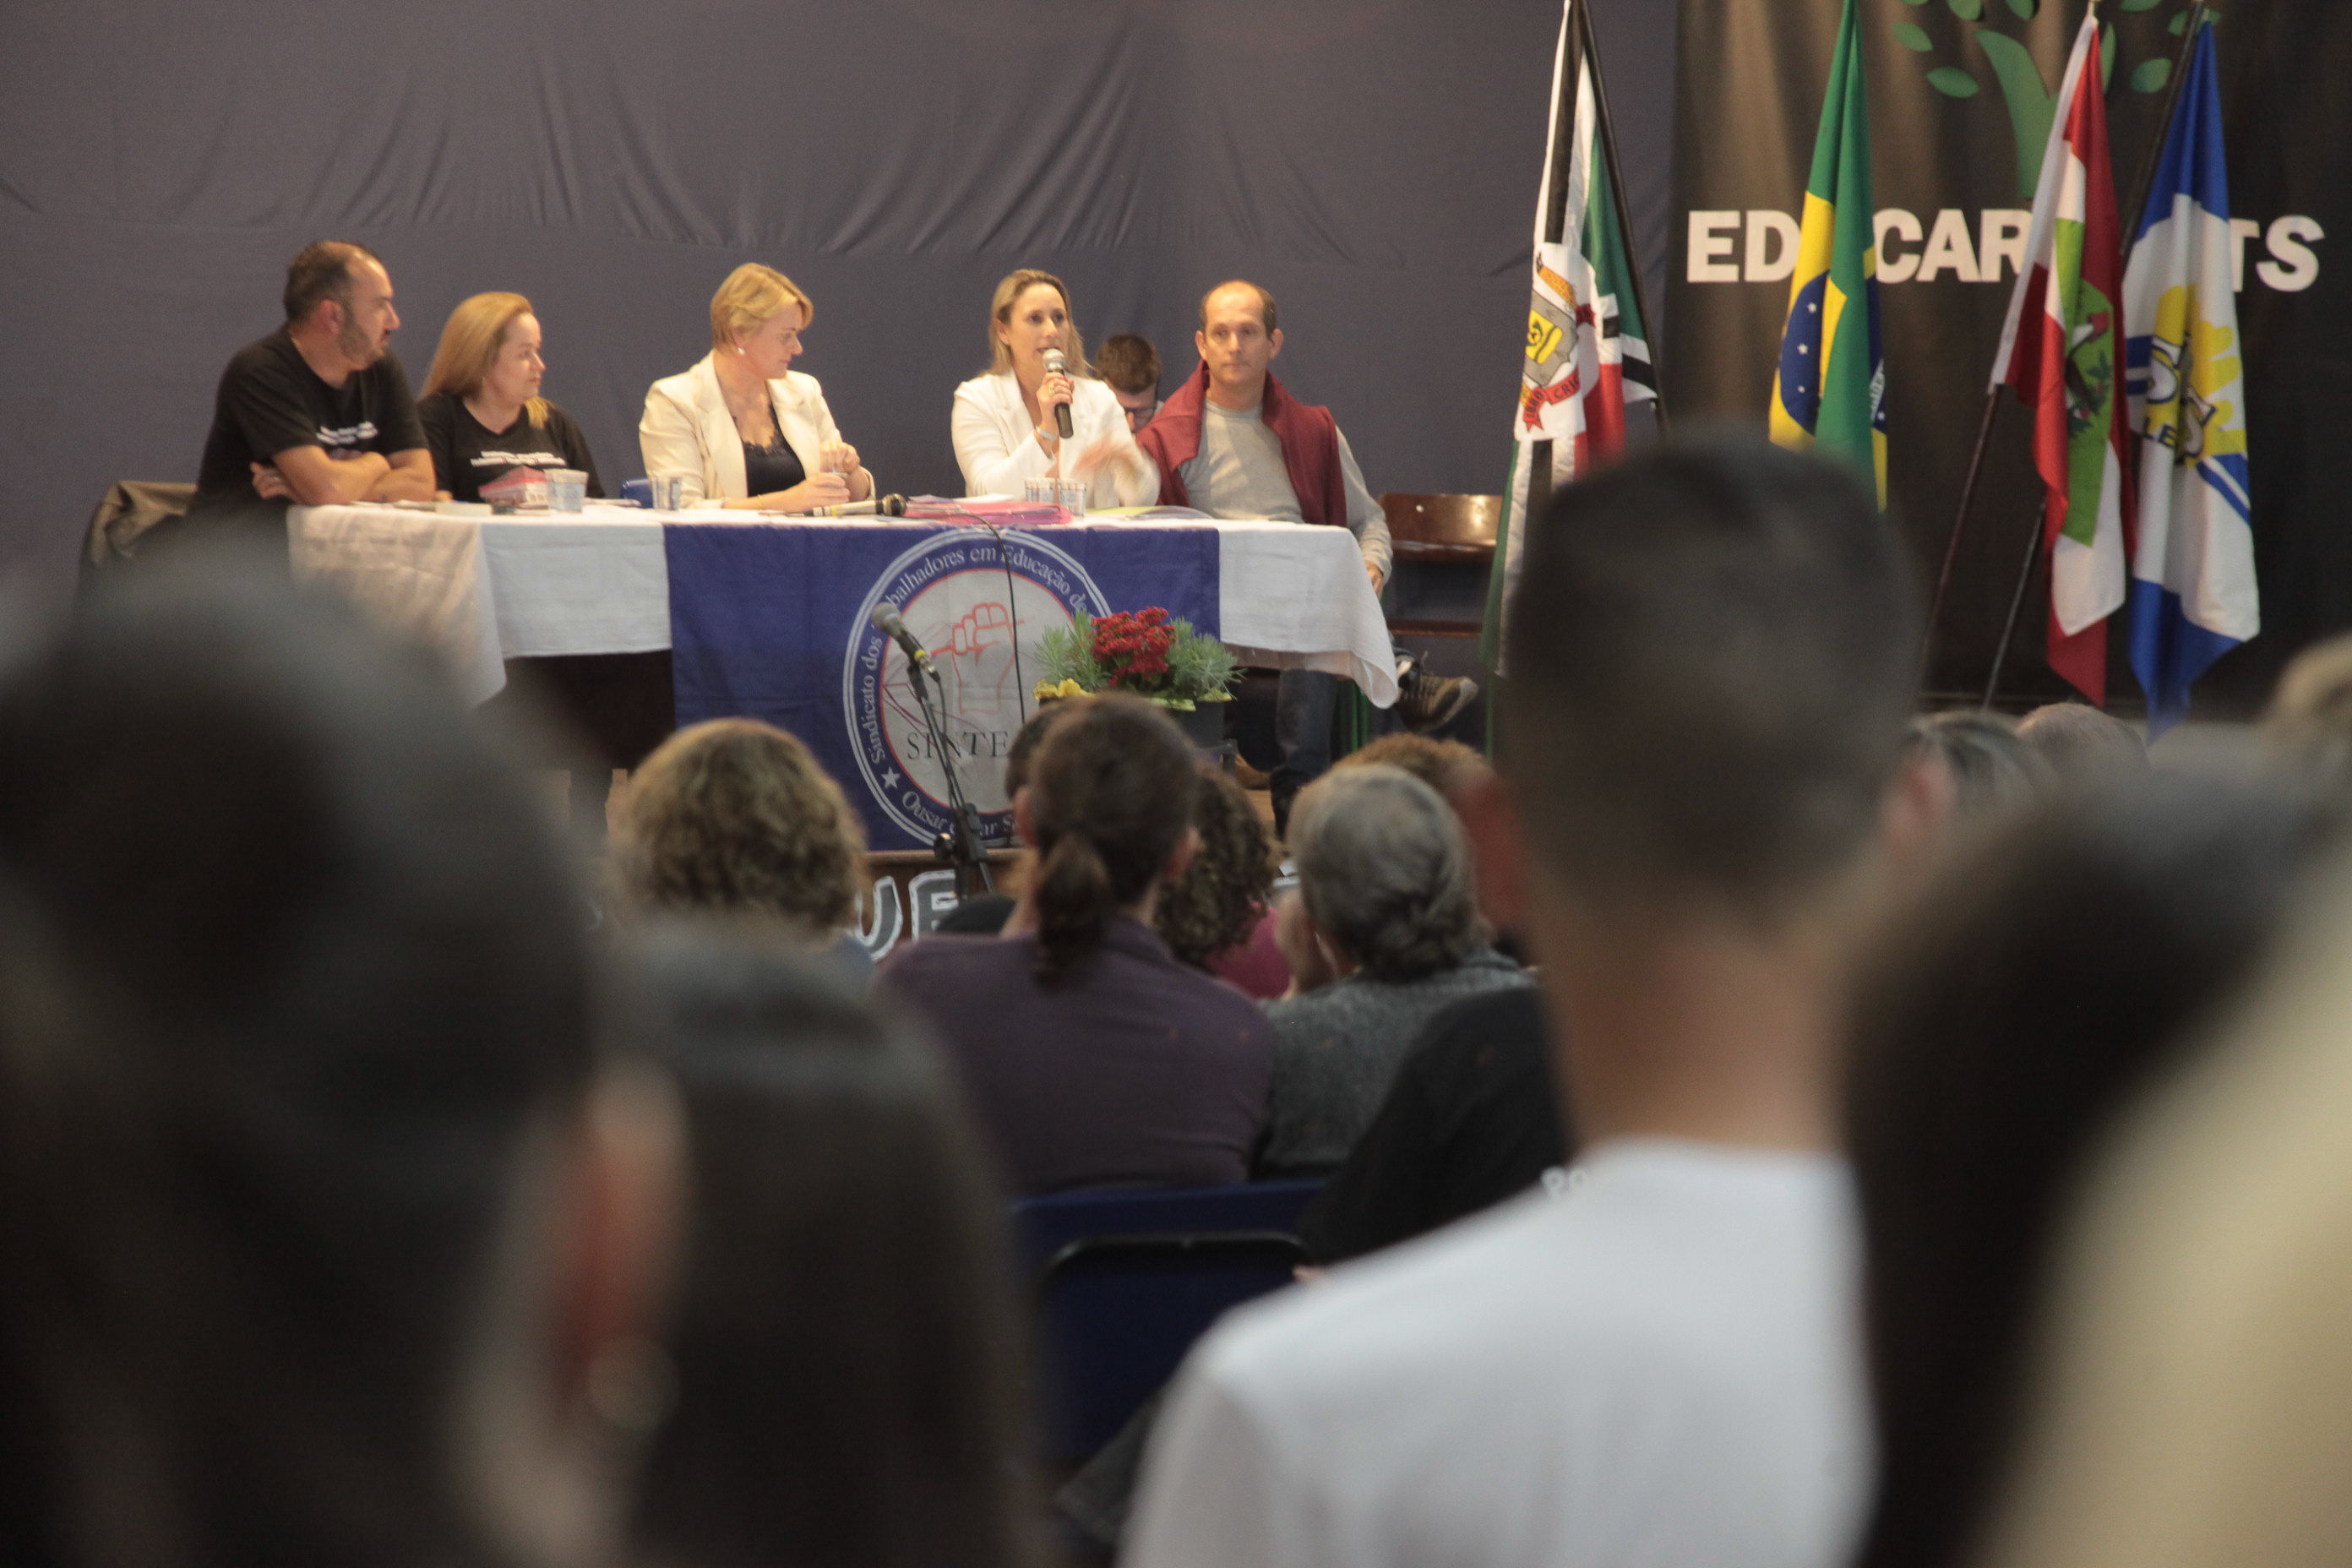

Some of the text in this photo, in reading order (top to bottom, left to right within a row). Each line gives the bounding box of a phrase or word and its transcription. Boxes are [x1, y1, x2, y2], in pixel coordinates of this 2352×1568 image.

[1687, 209, 2034, 284] EDCAR
[884, 547, 966, 607] balhadores
[969, 547, 997, 563] em
[861, 635, 883, 672] dos
[861, 674, 886, 765] Sindicato
[902, 791, 948, 831] Ousar
